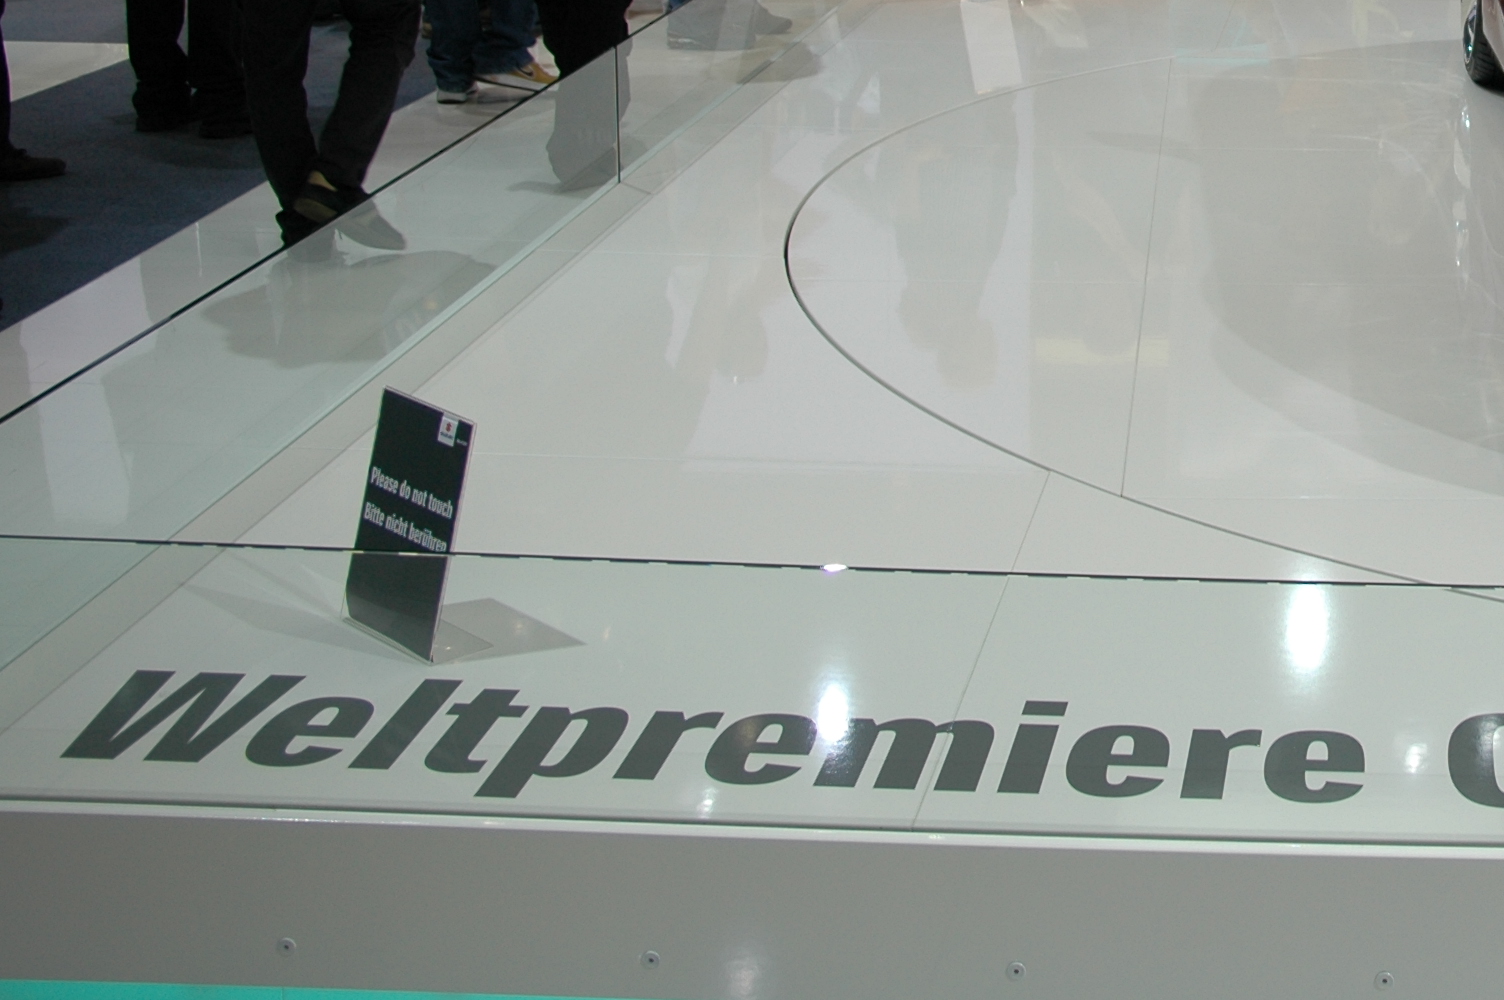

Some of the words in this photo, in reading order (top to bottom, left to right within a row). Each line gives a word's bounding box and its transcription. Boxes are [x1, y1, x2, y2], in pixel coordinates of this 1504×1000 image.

[370, 466, 399, 495] Please
[399, 479, 411, 500] do
[411, 487, 428, 509] not
[428, 493, 454, 520] touch
[363, 501, 385, 528] Bitte
[385, 513, 409, 539] nicht
[408, 522, 448, 553] berühren
[58, 668, 1366, 804] Weltpremiere
